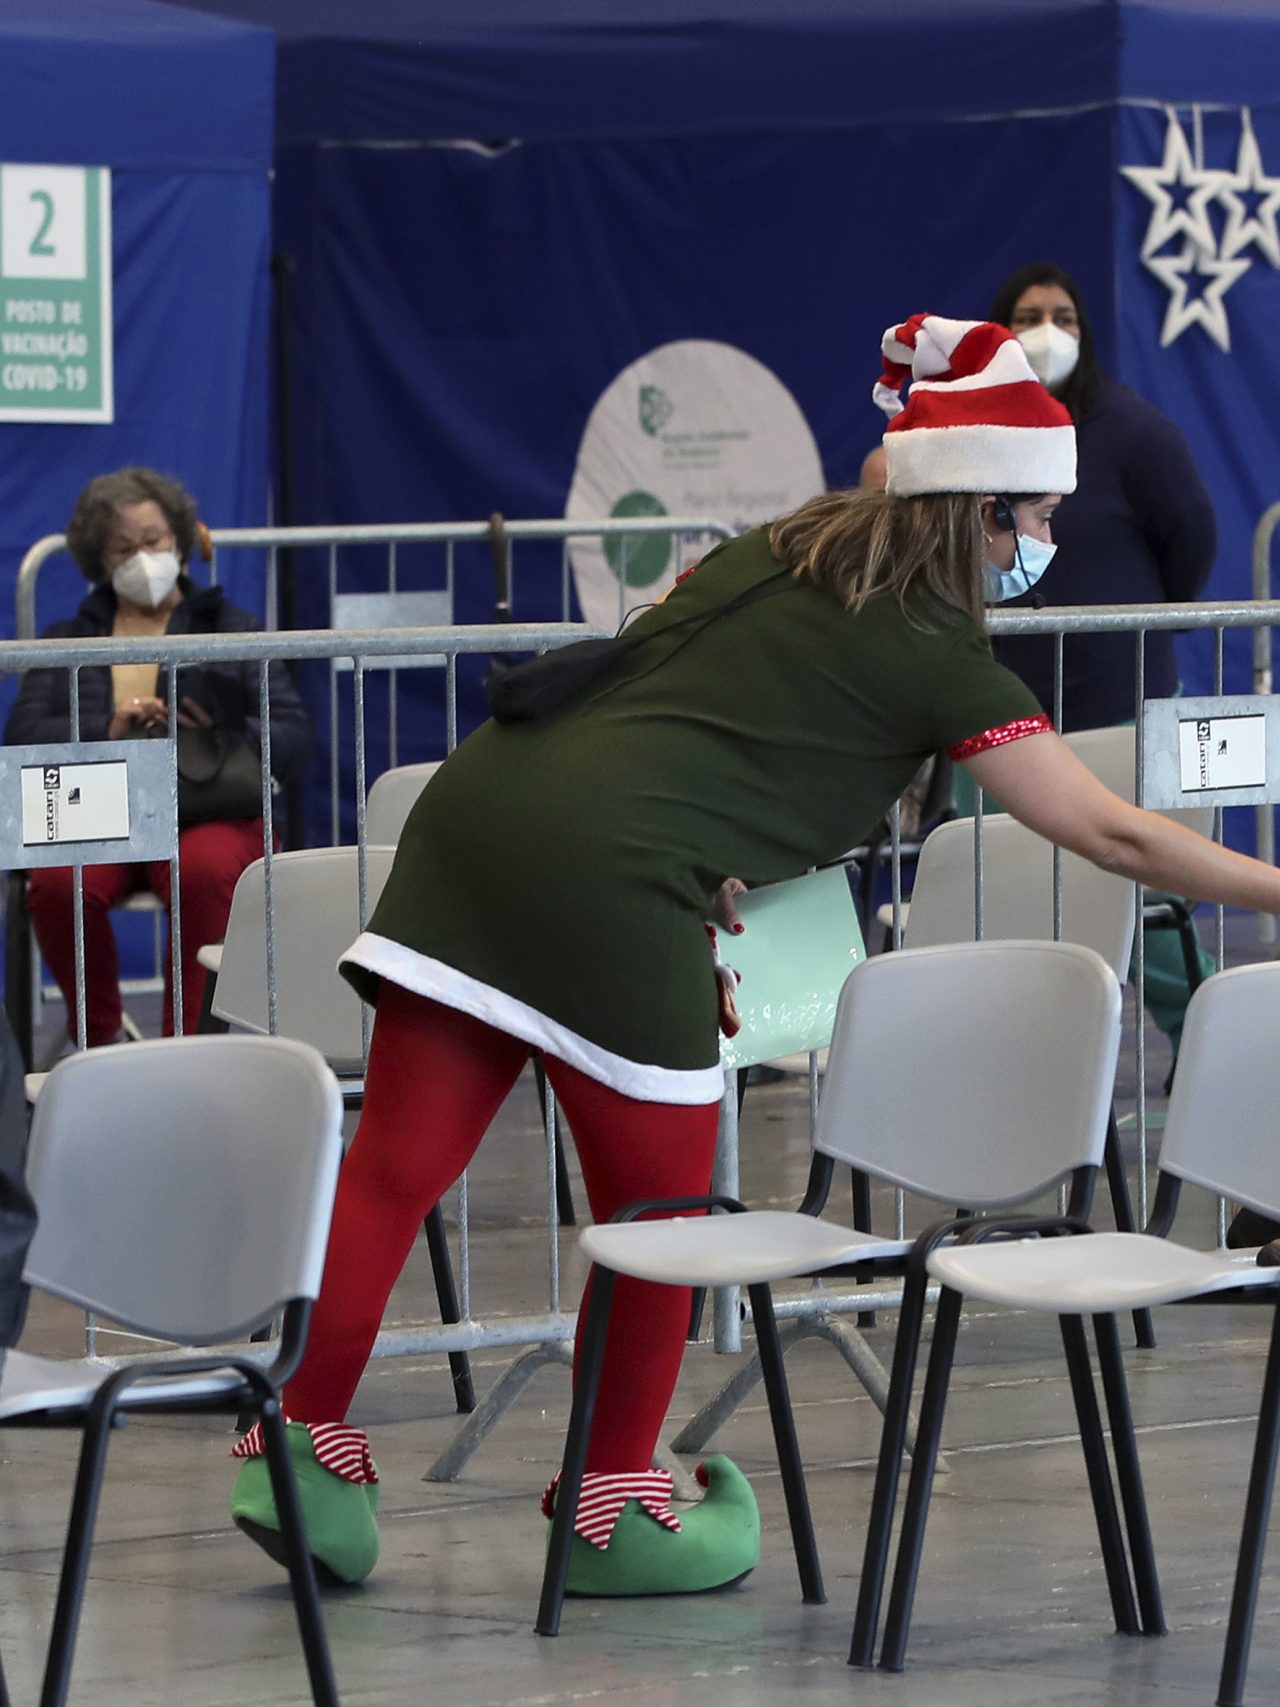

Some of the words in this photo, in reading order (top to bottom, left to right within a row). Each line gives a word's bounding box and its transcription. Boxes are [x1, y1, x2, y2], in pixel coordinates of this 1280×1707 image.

[28, 189, 55, 256] 2
[5, 300, 56, 324] POSTO
[61, 302, 82, 325] DE
[2, 331, 88, 361] VACINAÇÃO
[2, 363, 88, 391] COVID-19
[46, 791, 54, 840] catari
